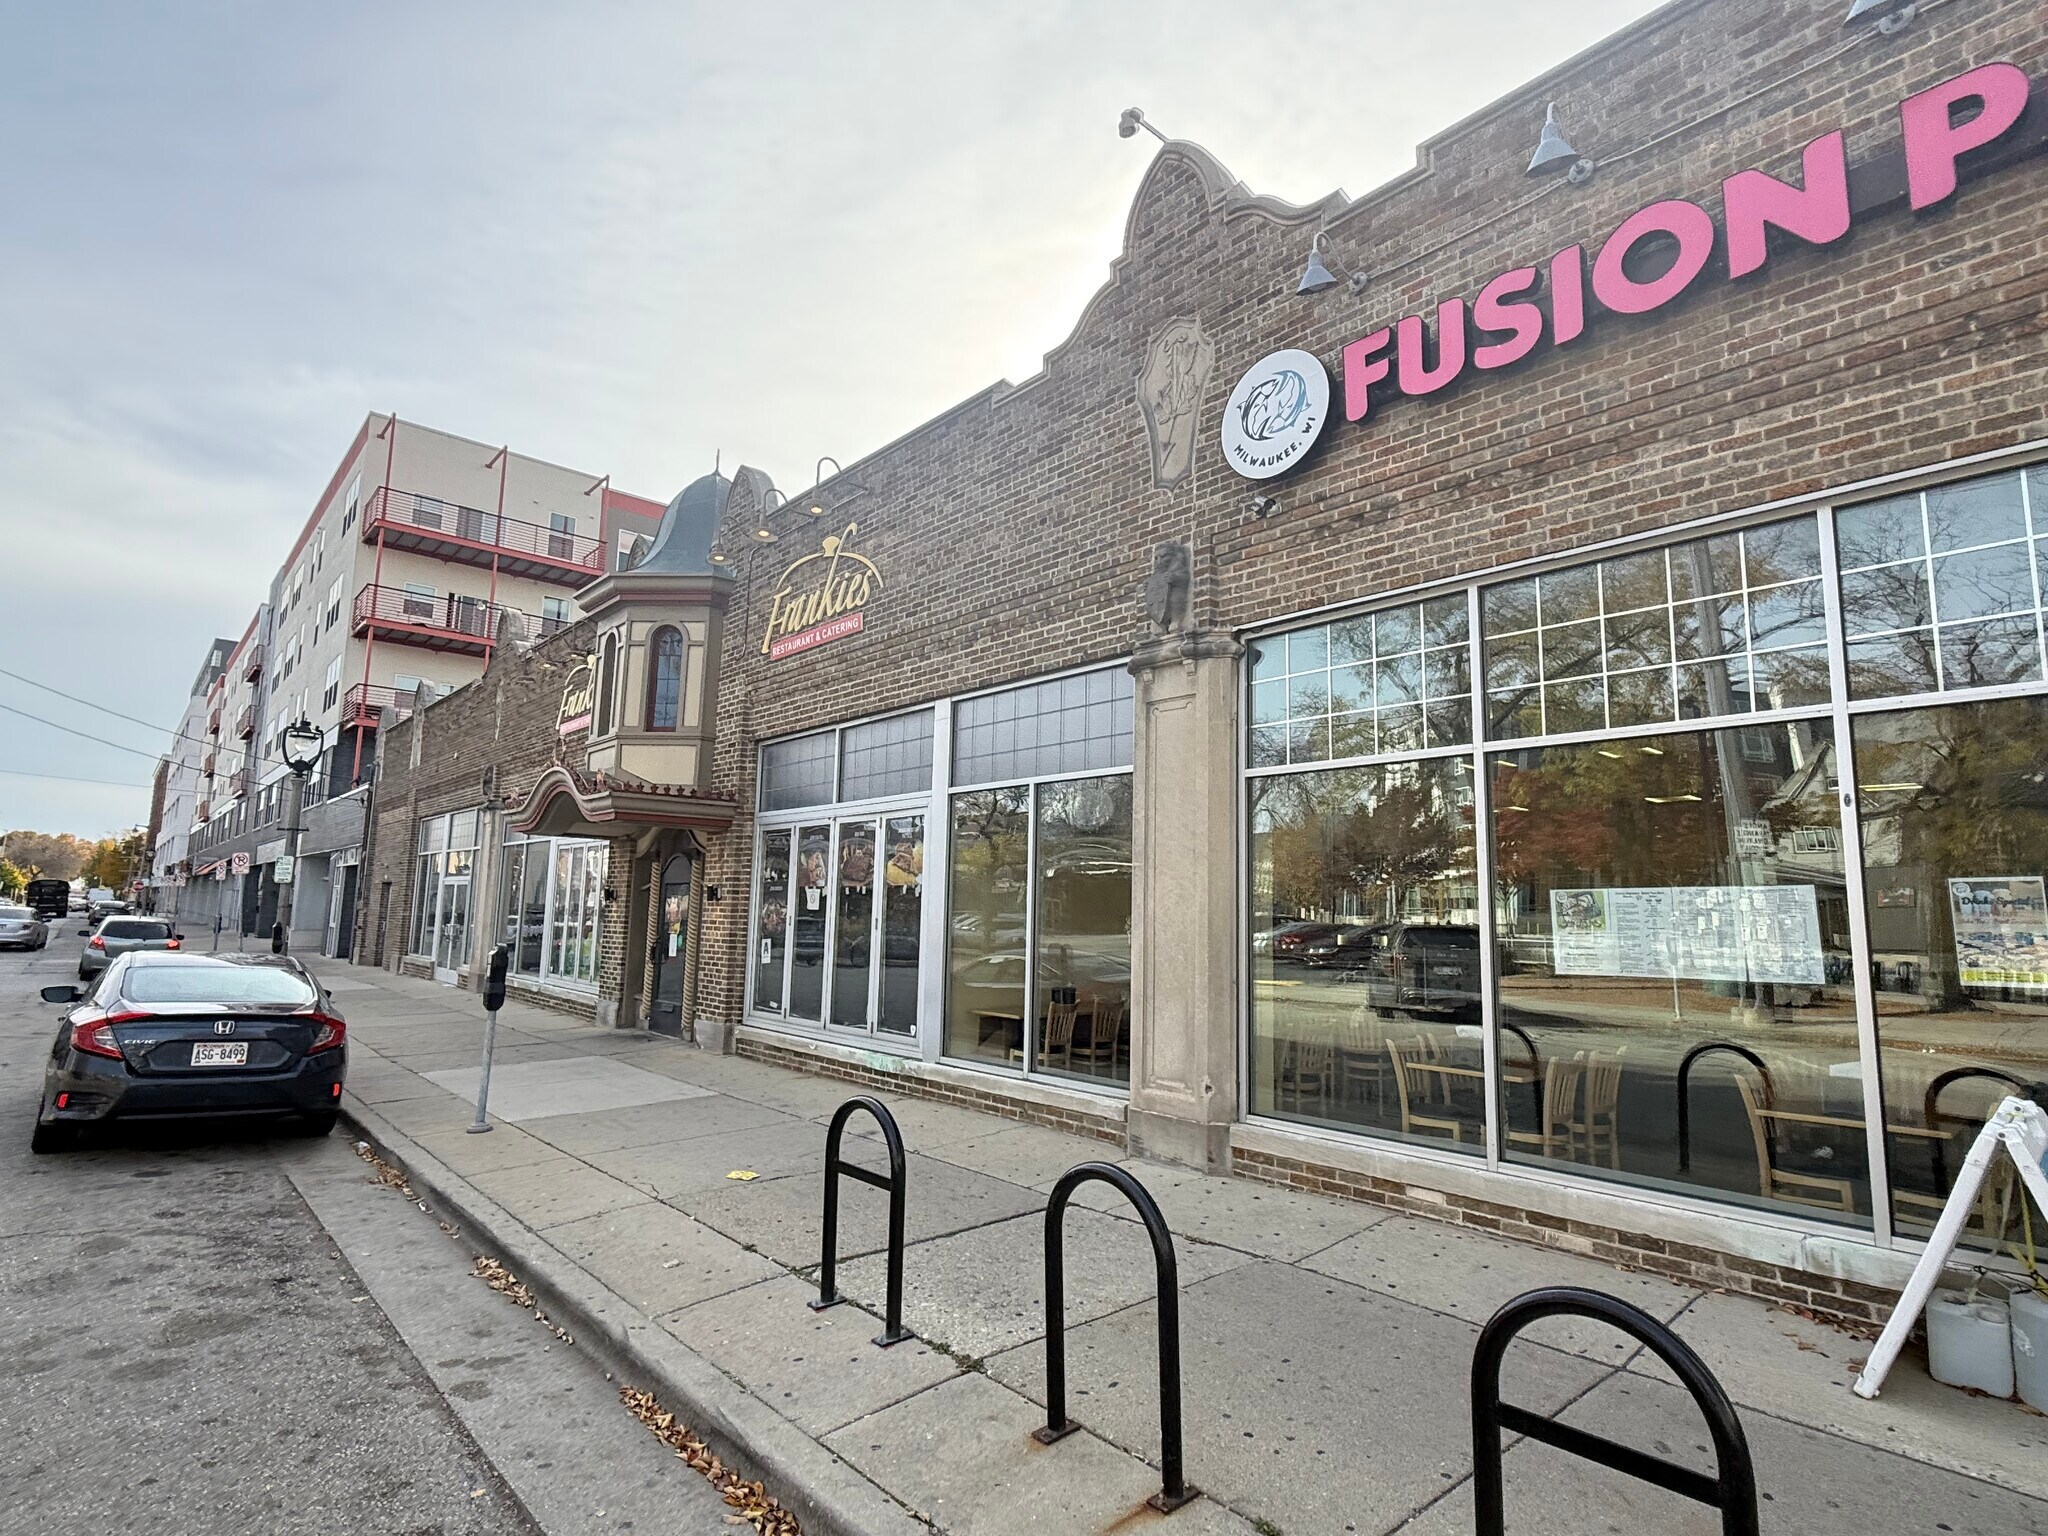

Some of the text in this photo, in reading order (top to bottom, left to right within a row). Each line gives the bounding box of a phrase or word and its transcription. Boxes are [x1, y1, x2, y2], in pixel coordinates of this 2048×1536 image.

[1341, 129, 1851, 421] FUSION
[1301, 417, 1316, 433] WI
[761, 522, 873, 654] Frankies
[772, 617, 859, 657] RESTAURANT & CATERING
[555, 660, 595, 730] Frank
[194, 1048, 246, 1061] ASG-8499
